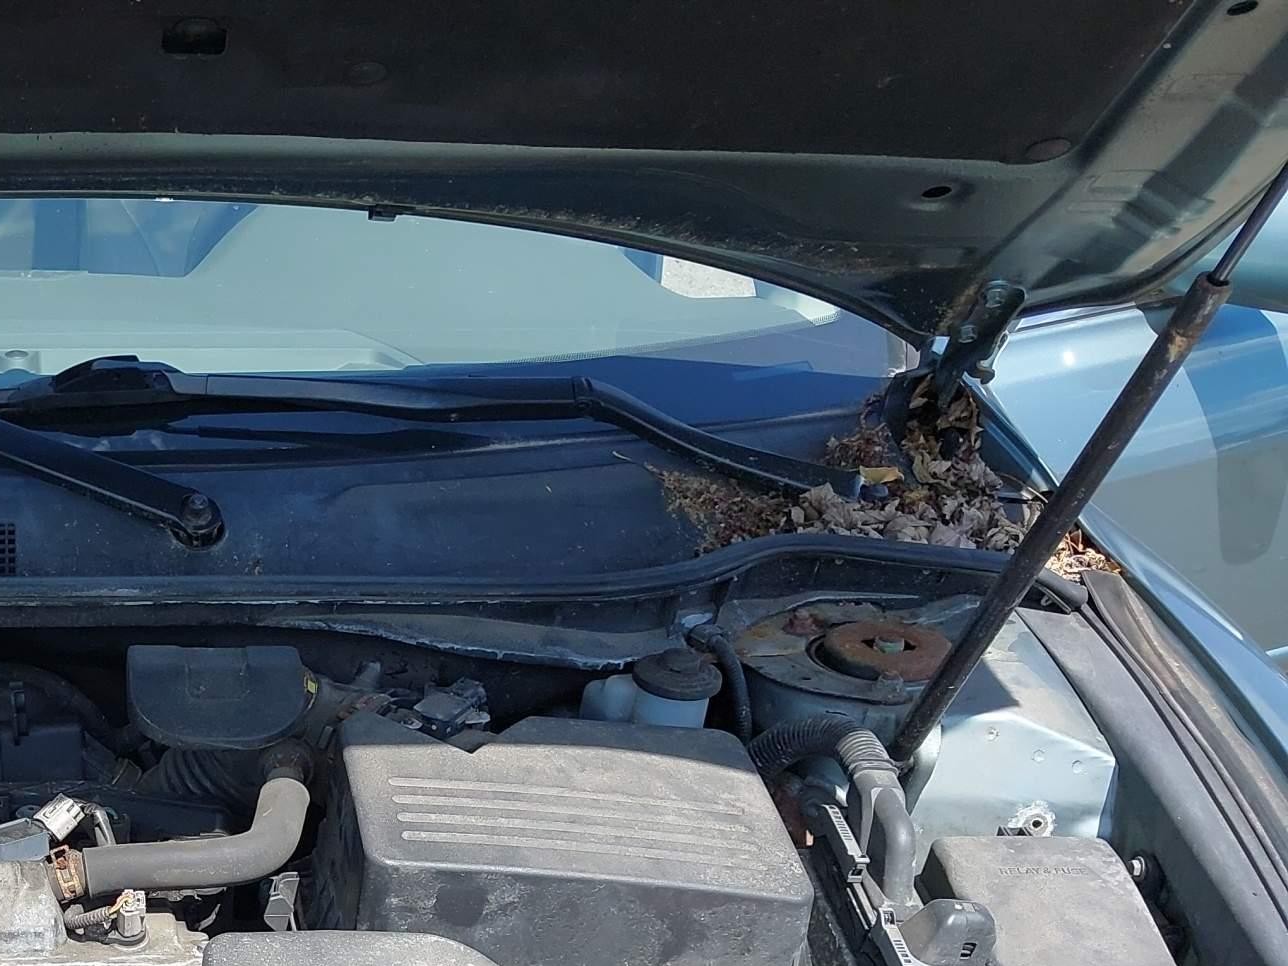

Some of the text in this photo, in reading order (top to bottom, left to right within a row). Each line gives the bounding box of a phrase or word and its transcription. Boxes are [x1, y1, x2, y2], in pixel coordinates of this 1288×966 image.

[999, 866, 1089, 876] RELAY & FUSE
